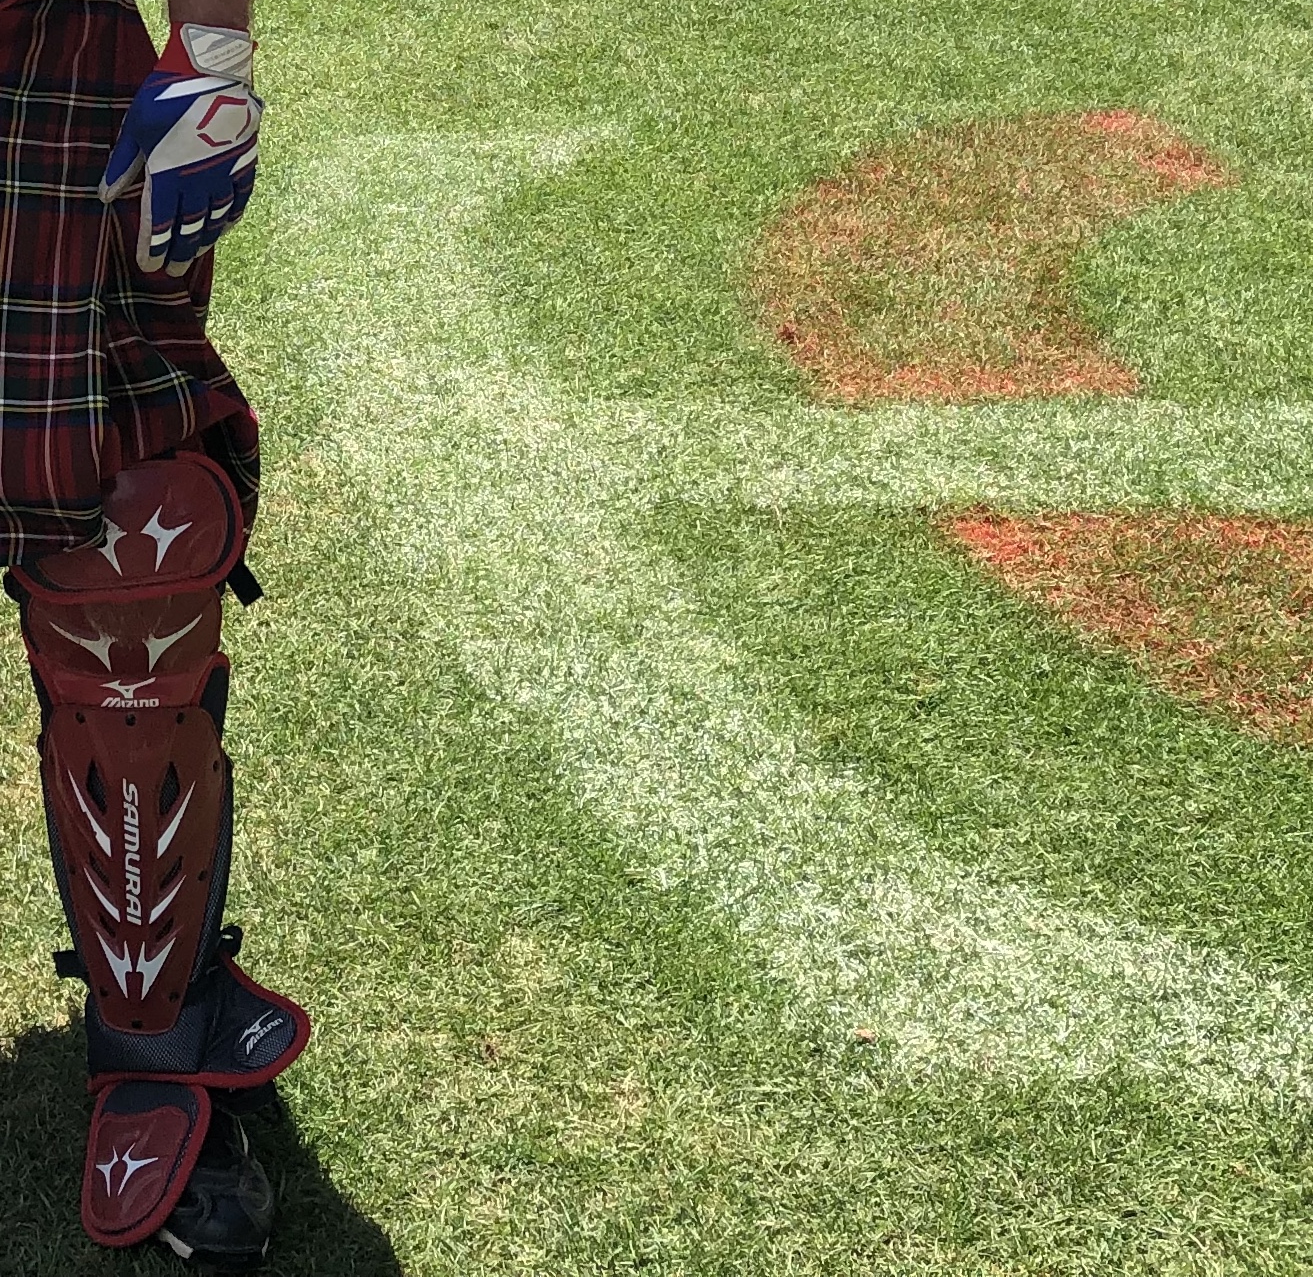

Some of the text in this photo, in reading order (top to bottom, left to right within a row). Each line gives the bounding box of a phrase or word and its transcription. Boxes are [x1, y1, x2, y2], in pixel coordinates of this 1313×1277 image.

[100, 696, 160, 708] MIZUNO
[122, 777, 142, 926] SAMURAI
[245, 1017, 284, 1056] MIZUNO
